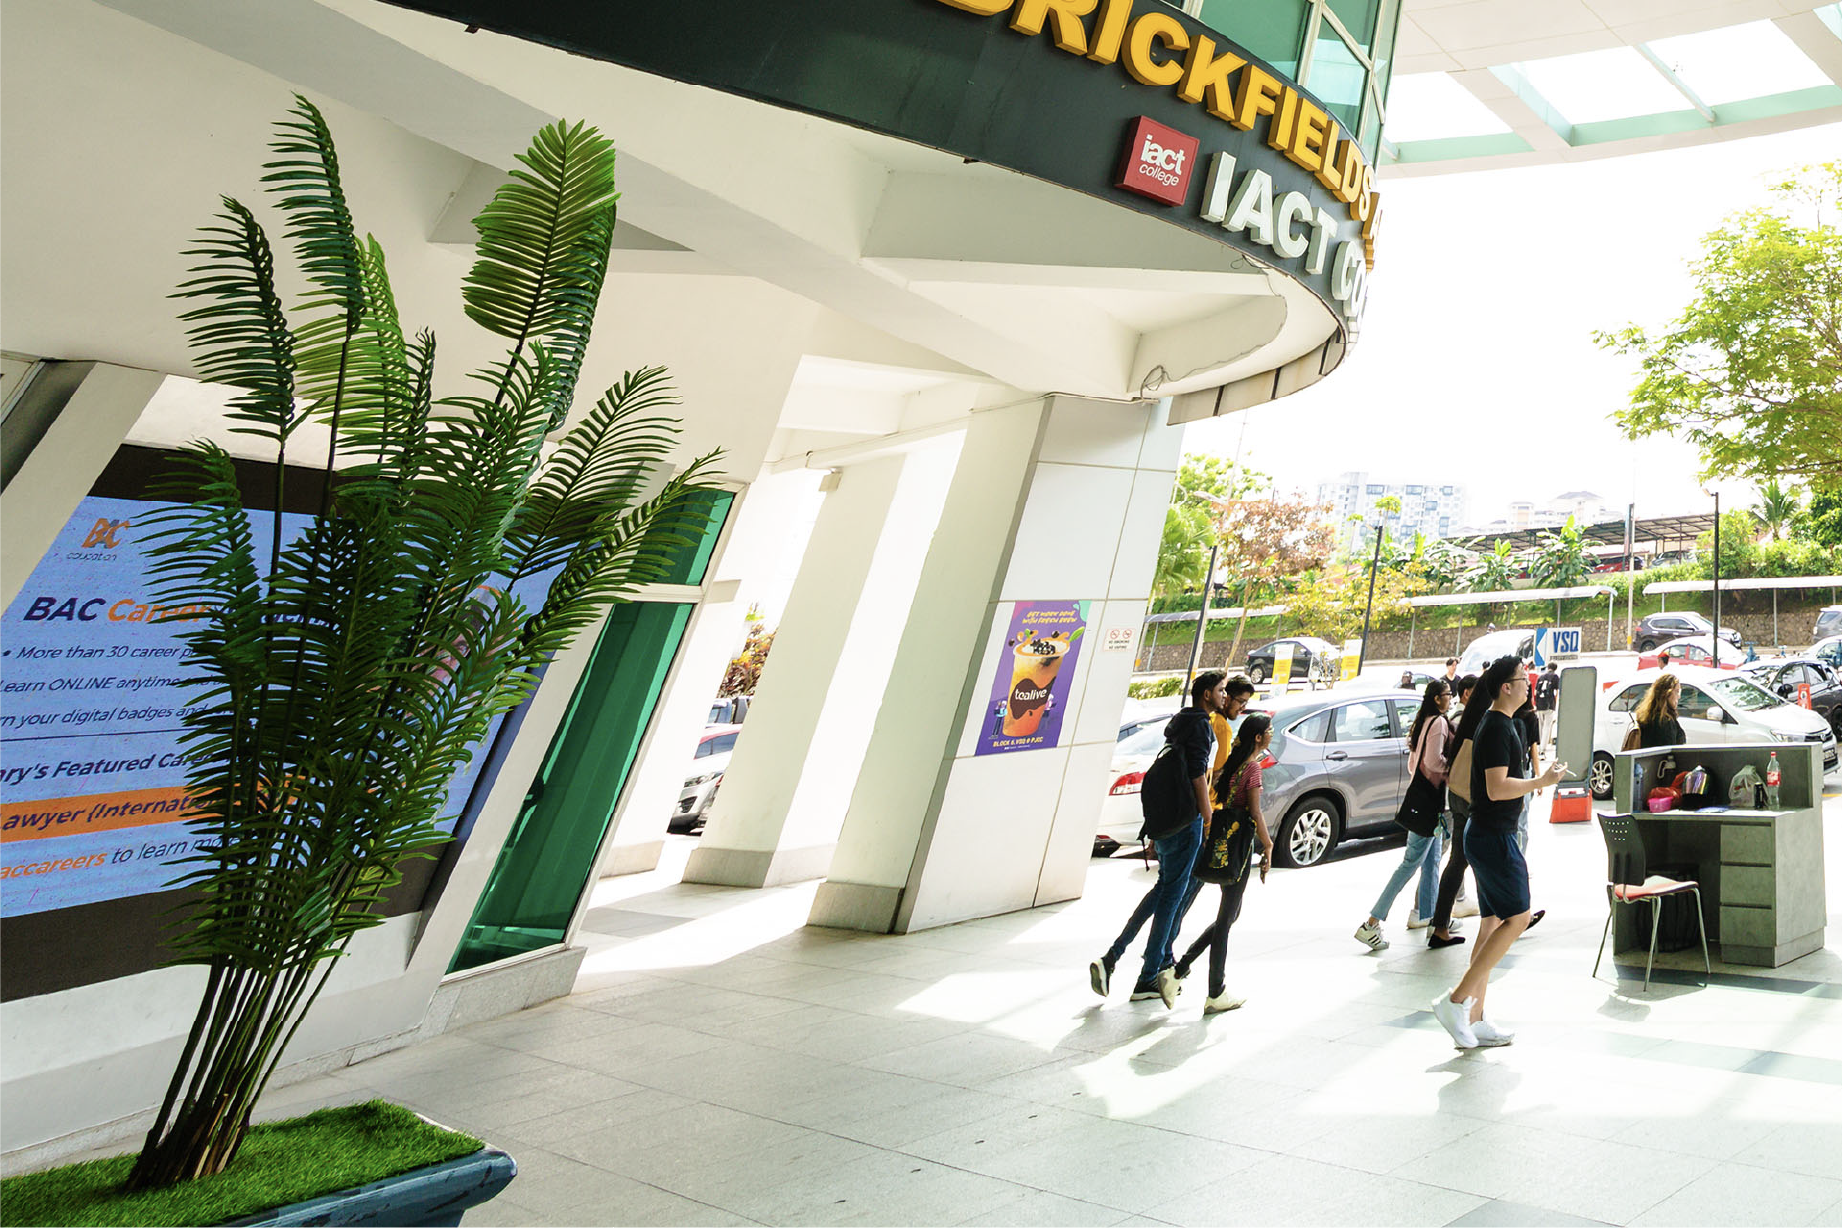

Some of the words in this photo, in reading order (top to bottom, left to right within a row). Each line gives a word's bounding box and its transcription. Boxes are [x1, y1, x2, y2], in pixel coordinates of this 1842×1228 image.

[1140, 134, 1186, 176] iact
[1139, 163, 1180, 187] college
[1201, 150, 1338, 275] IACT
[23, 596, 107, 621] BAC
[16, 645, 63, 659] More
[65, 645, 105, 659] than
[106, 645, 129, 658] 30
[130, 648, 181, 659] career
[1553, 630, 1580, 654] VSQ
[48, 676, 117, 691] ONLINE
[1014, 688, 1048, 701] tealive
[15, 713, 60, 729] your
[61, 707, 118, 726] digital
[116, 706, 176, 722] badges
[51, 754, 157, 778] Featured
[0, 809, 86, 832] awyer
[111, 847, 134, 865] to
[137, 840, 188, 861] learn
